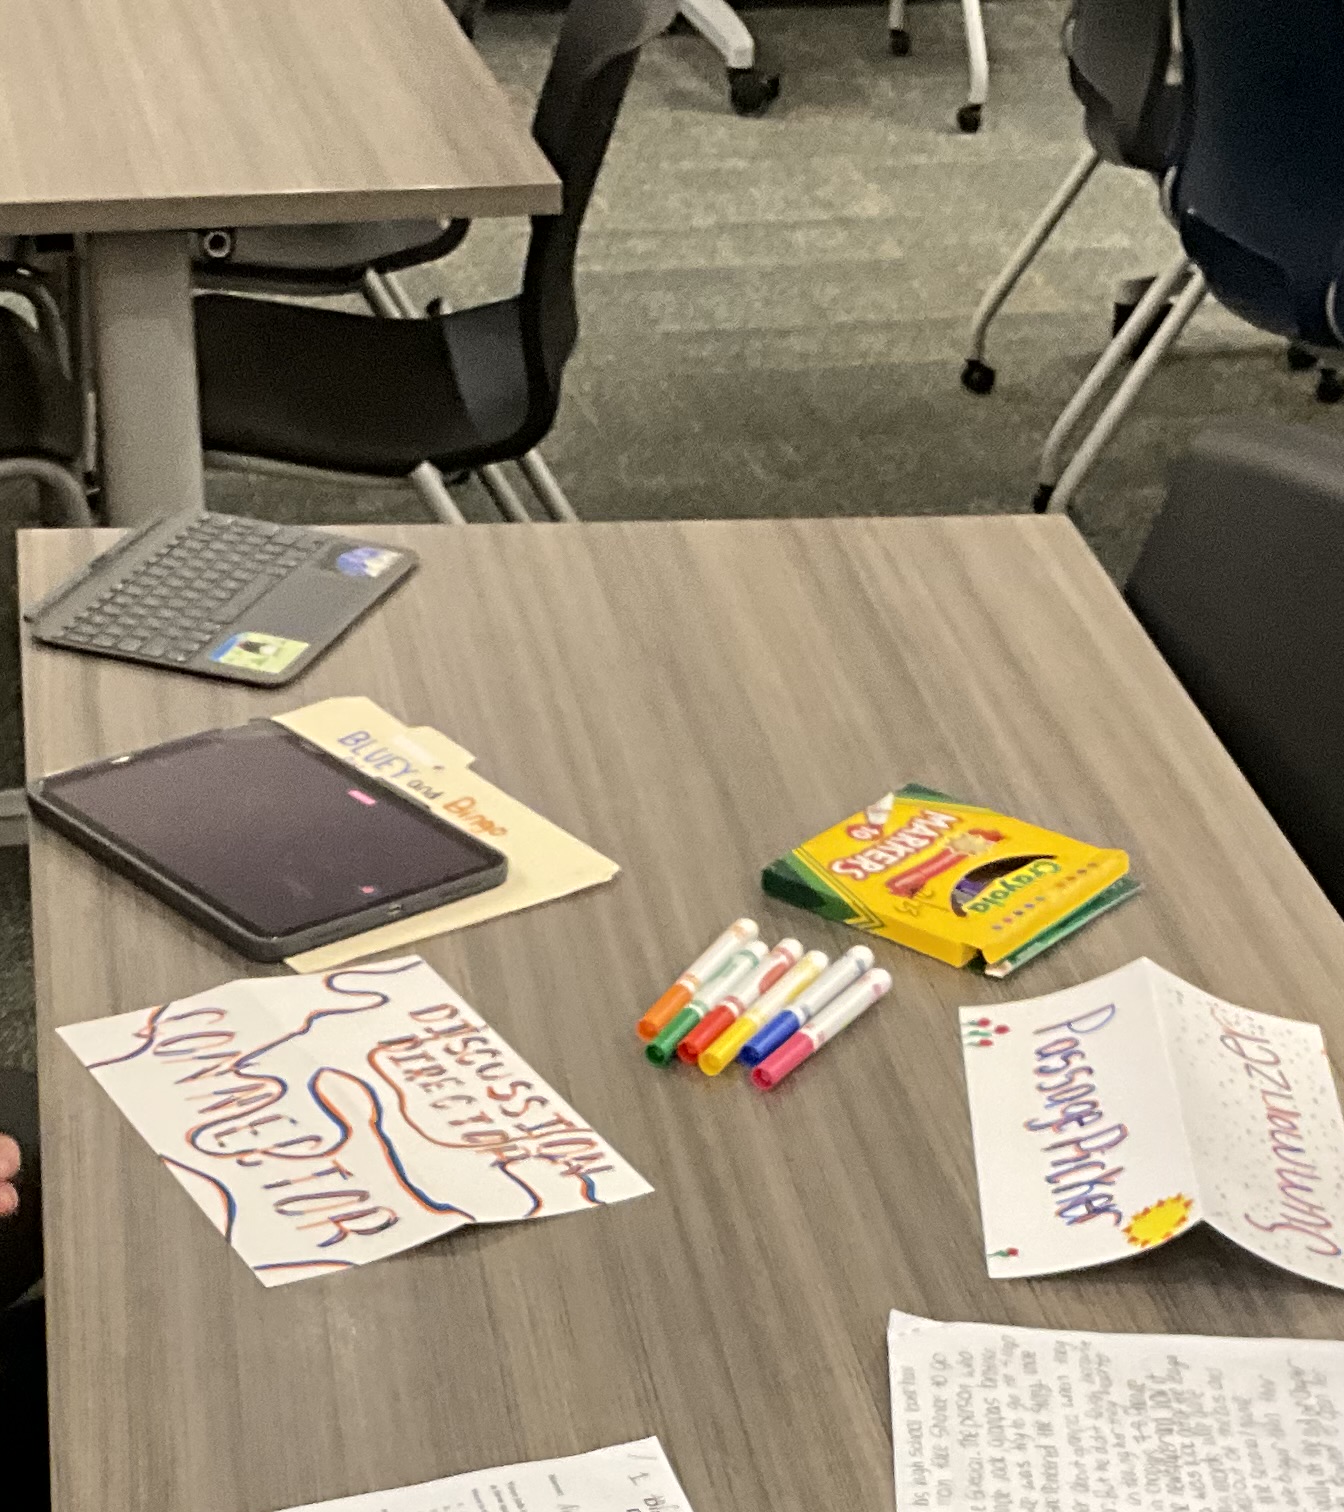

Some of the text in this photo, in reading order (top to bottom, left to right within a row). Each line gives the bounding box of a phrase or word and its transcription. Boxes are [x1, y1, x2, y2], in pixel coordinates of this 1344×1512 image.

[337, 731, 507, 836] BLUEY and Bingo
[851, 824, 878, 840] 10
[831, 810, 958, 880] MARKERS
[968, 860, 1061, 915] Crayola
[132, 1007, 400, 1248] CONNECTOR
[378, 1034, 531, 1167] DIRECTOR
[410, 1003, 614, 1176] DISCUSSION
[1024, 1004, 1129, 1227] Passage Picker
